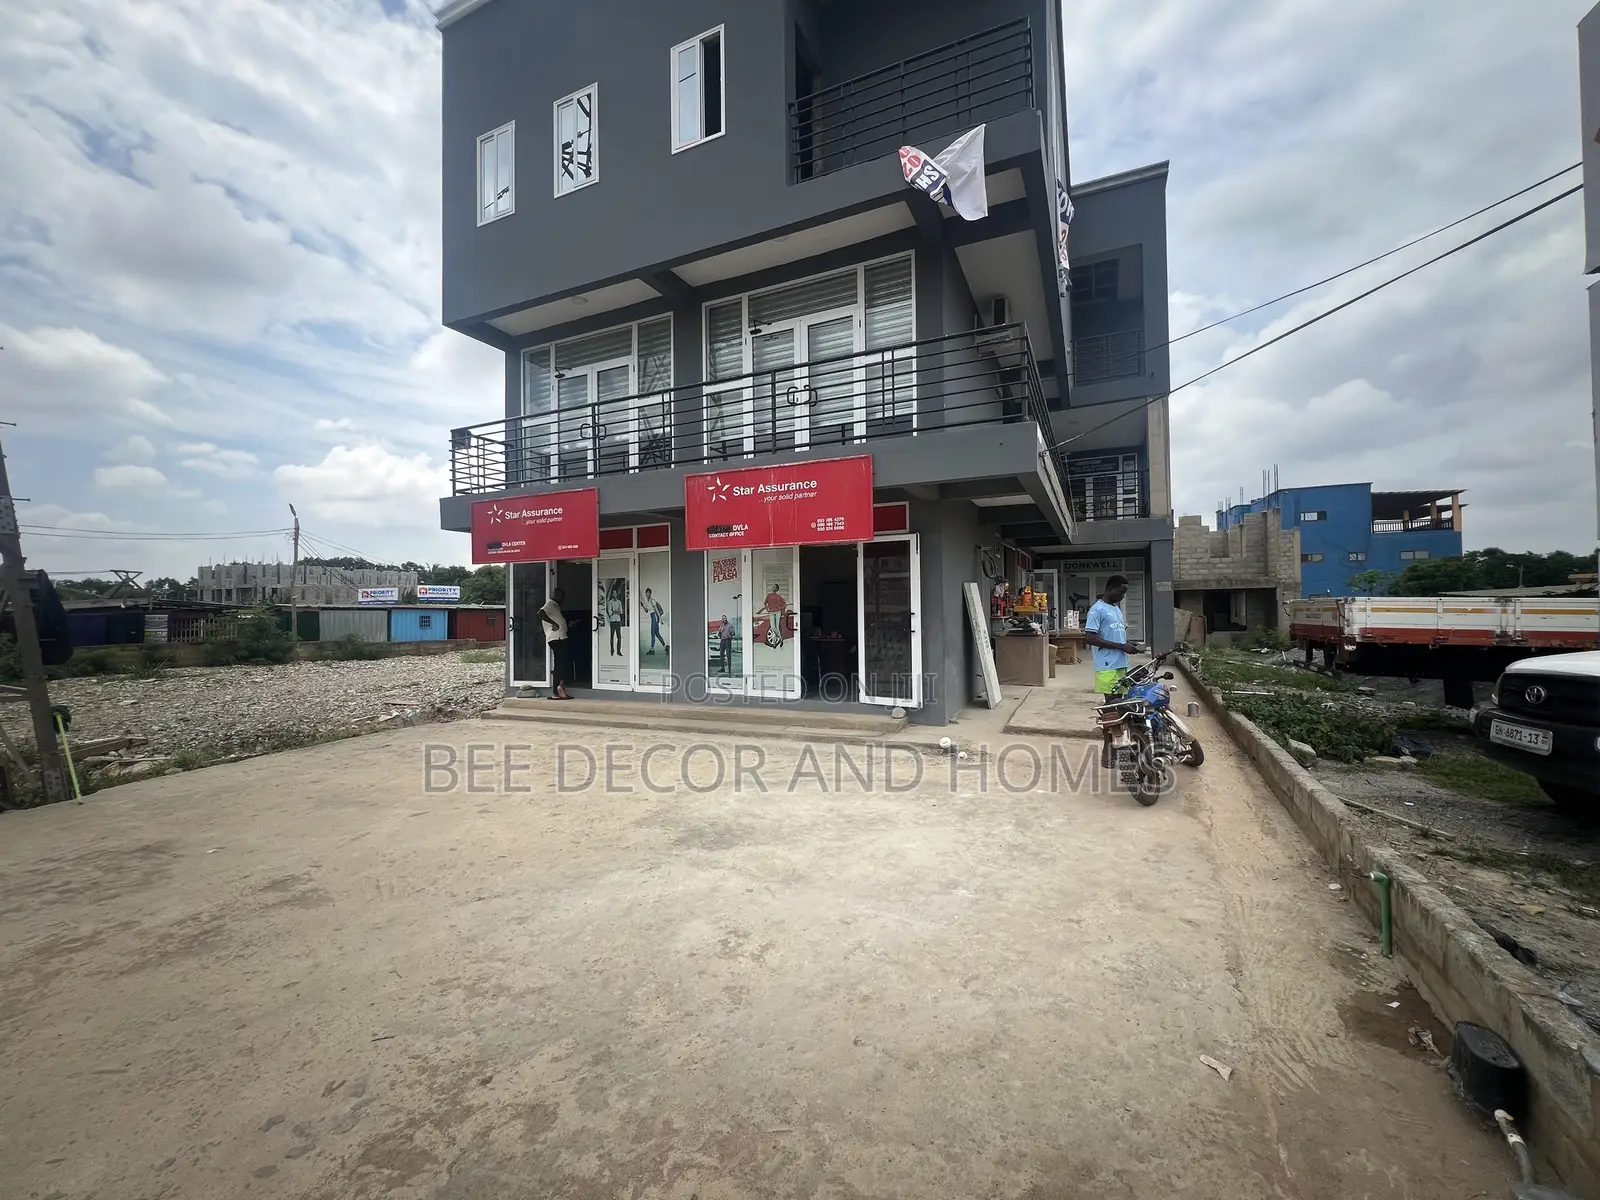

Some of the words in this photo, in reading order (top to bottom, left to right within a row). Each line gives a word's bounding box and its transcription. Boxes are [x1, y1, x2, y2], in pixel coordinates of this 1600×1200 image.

[733, 486, 755, 497] Star
[757, 480, 818, 494] Assurance
[778, 493, 793, 502] solid
[794, 490, 818, 502] partner
[505, 510, 520, 520] Star
[521, 507, 563, 518] Assurance
[732, 523, 749, 532] DVLA
[1064, 560, 1118, 569] DONEWELL
